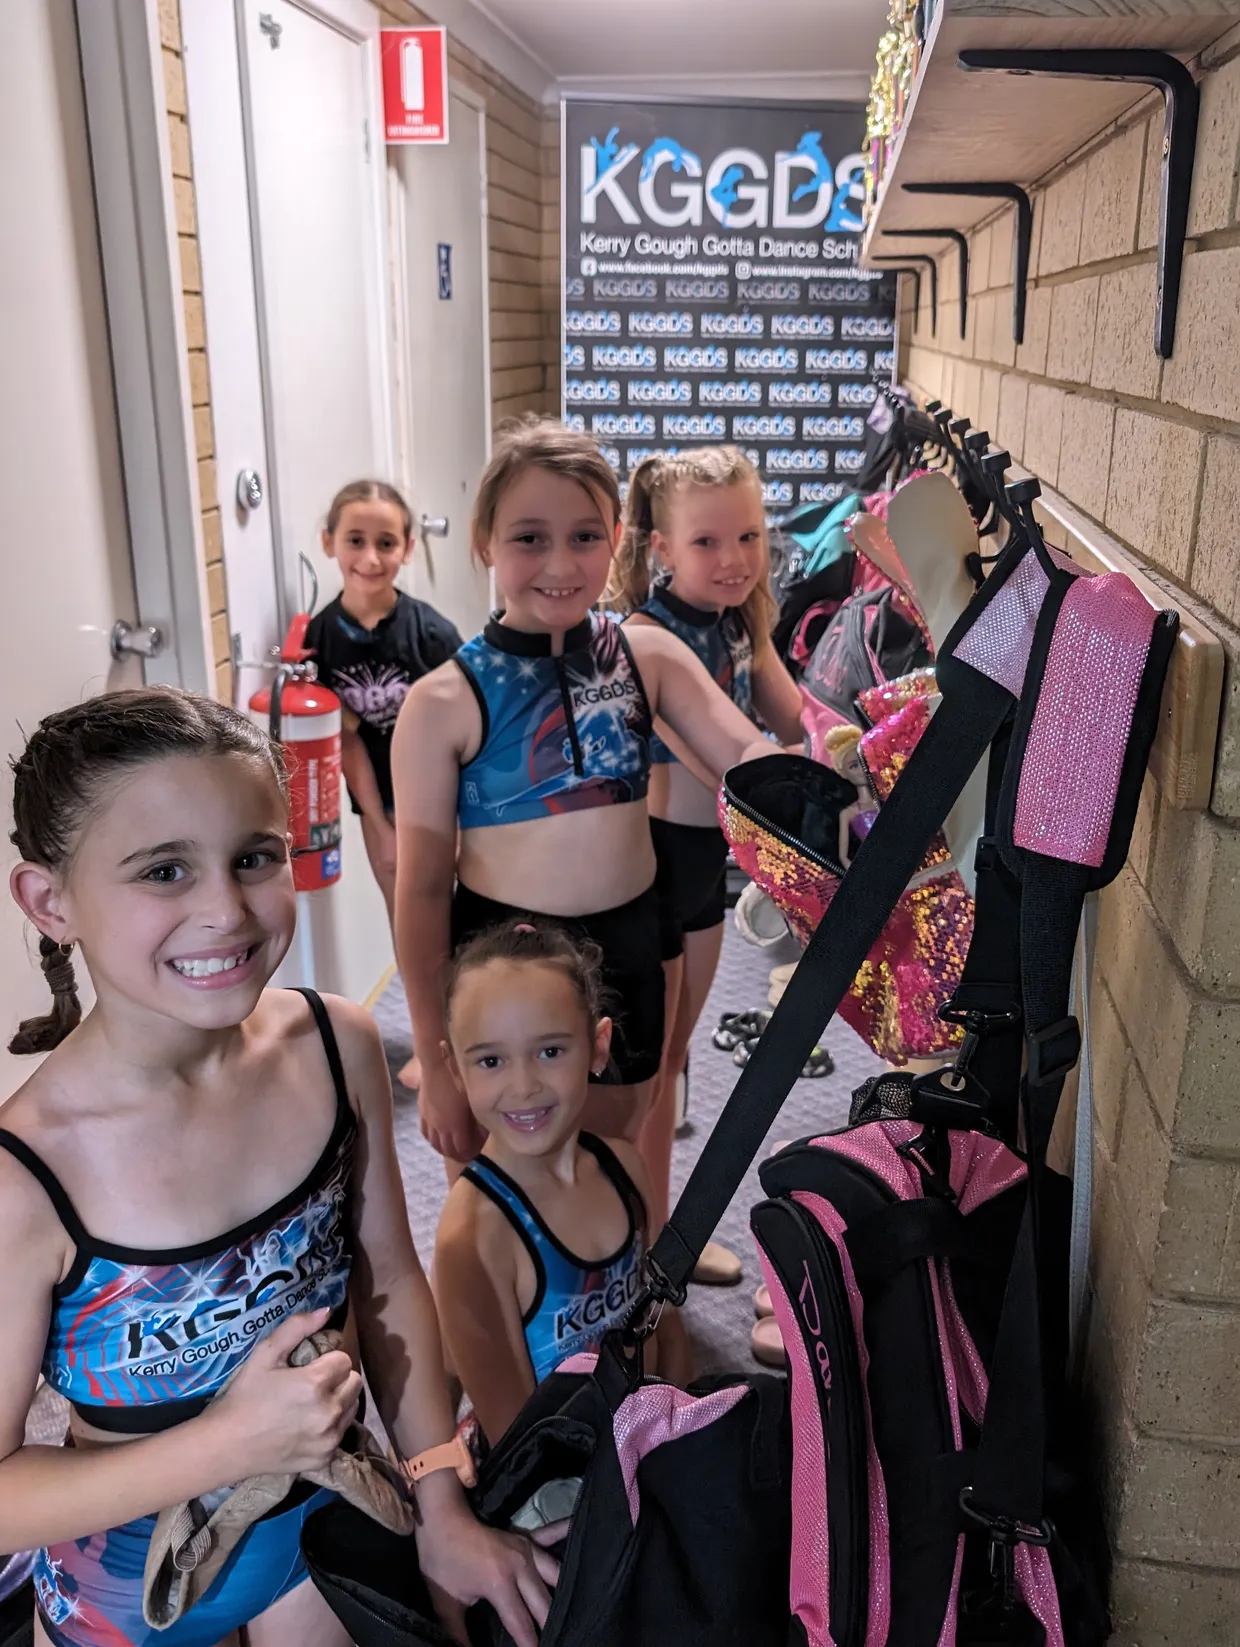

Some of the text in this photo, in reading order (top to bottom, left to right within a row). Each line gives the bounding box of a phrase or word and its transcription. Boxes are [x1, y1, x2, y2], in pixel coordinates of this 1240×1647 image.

[580, 138, 866, 232] KGGDS
[580, 231, 859, 260] Kerry Gough Gotta Dance Sch
[592, 279, 657, 297] KGGDS
[665, 280, 729, 298] KGGDS
[737, 282, 800, 300] KGGDS
[628, 310, 693, 333] KGGDS
[701, 312, 764, 334] KGGDS
[771, 314, 835, 335] KGGDS
[841, 316, 894, 337] KGGD
[592, 344, 657, 367] KGGDS
[664, 345, 728, 368] KGGDS
[735, 346, 799, 369] KGGDS
[805, 348, 868, 370] KGGDS
[627, 377, 692, 401] KGGDS
[699, 379, 762, 402] KGGDS
[768, 381, 832, 403] KGGDS
[838, 383, 878, 403] KGG
[592, 412, 656, 435] KGGDS
[663, 413, 726, 436] KGGDS
[732, 414, 796, 437] KGGDS
[802, 416, 865, 437] KGGDS
[766, 448, 829, 470] KGGDS
[799, 482, 843, 502] KGG
[556, 1269, 640, 1340] KGGD
[129, 1357, 177, 1376] Kerry
[182, 1331, 240, 1364] Gough
[243, 1304, 285, 1335] Gotta
